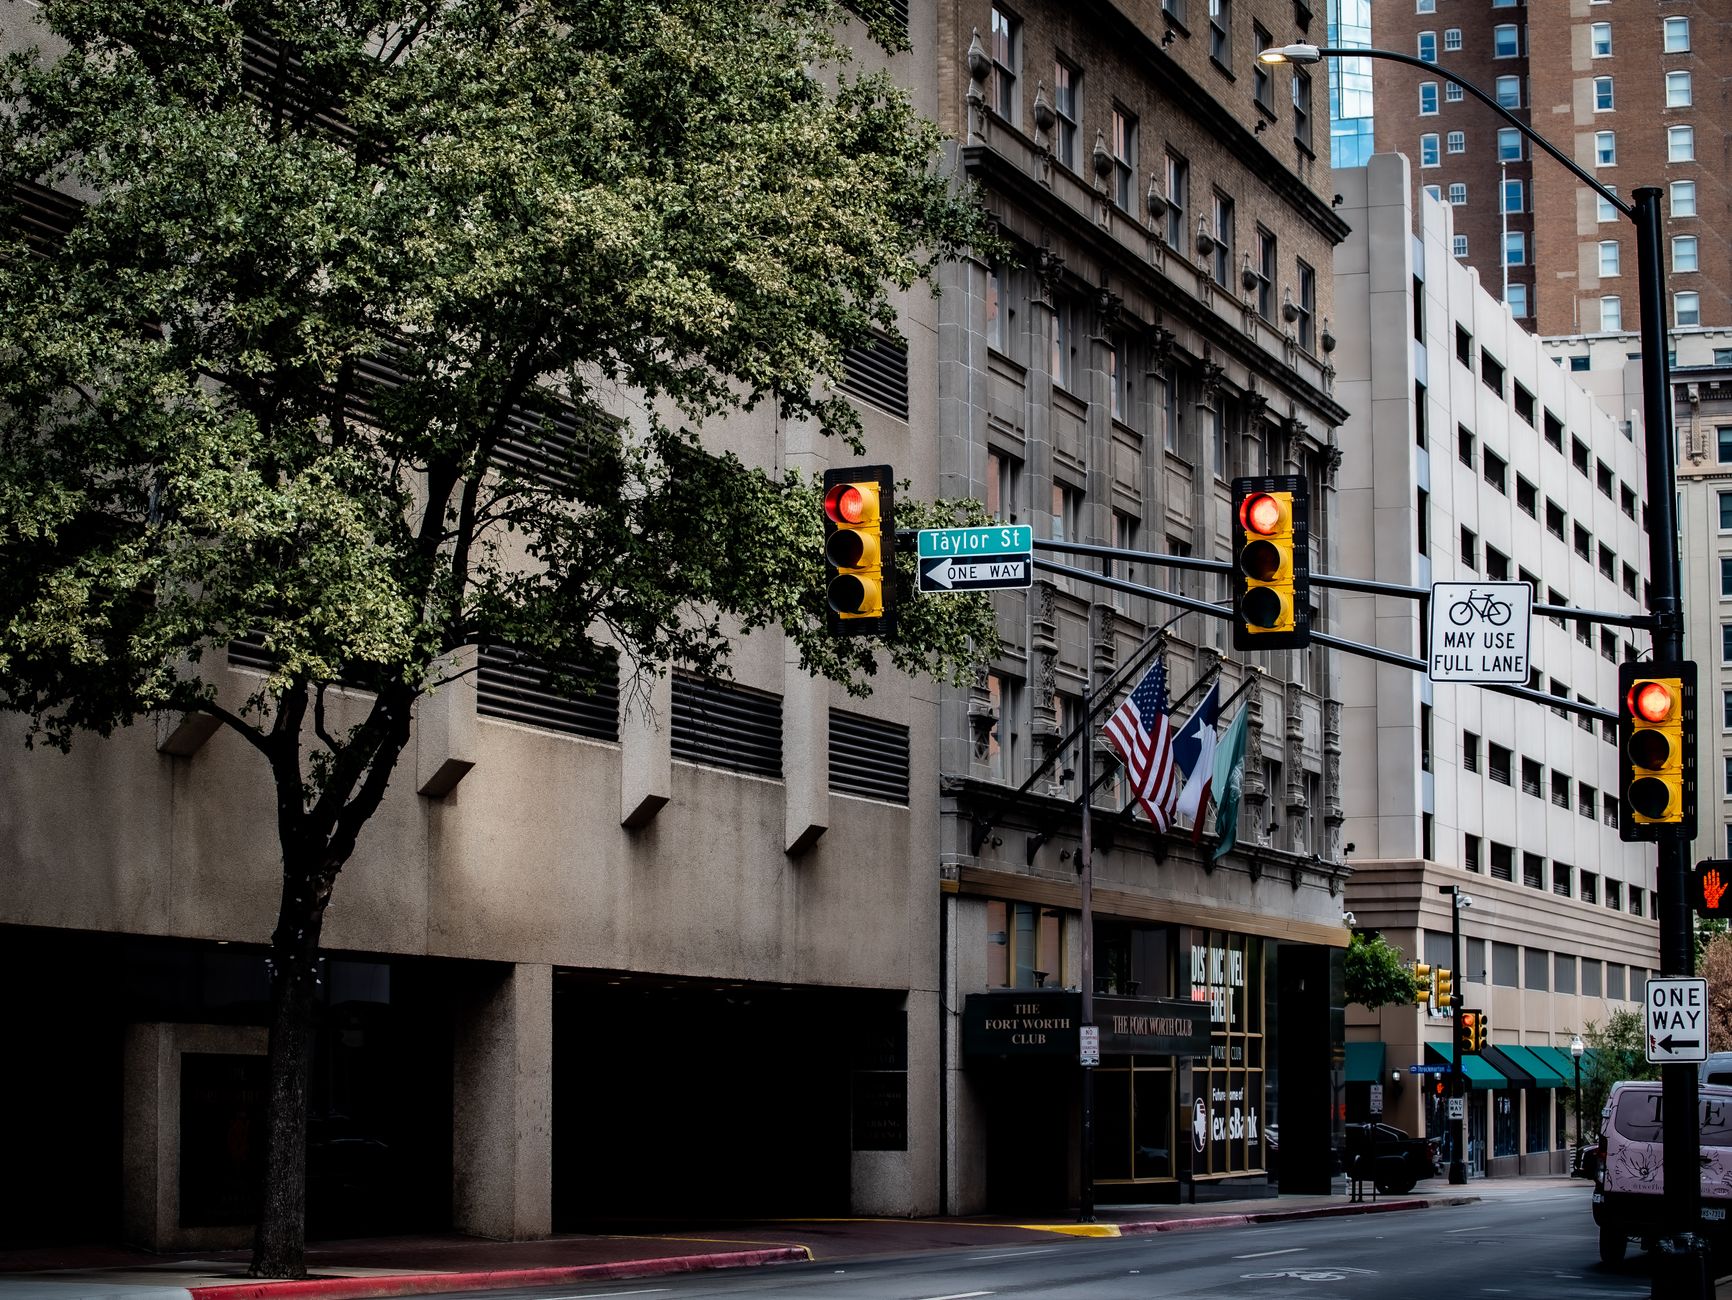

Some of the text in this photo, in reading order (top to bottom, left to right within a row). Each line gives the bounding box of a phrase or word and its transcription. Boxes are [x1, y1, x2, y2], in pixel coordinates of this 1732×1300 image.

[930, 529, 1020, 554] Taylor St
[947, 564, 1020, 580] ONE WAY
[1444, 631, 1515, 648] MAY USE
[1435, 654, 1523, 672] FULL LANE
[1652, 988, 1700, 1007] ONE
[1013, 1004, 1040, 1015] THE
[985, 1018, 1071, 1030] FORT WORTH
[1112, 1015, 1193, 1037] THE FORT WORTH CLUB
[1652, 1010, 1701, 1029] WAY
[1011, 1033, 1046, 1045] CLUB
[1647, 1095, 1725, 1127] TE
[1210, 1107, 1258, 1141] TexsBank
